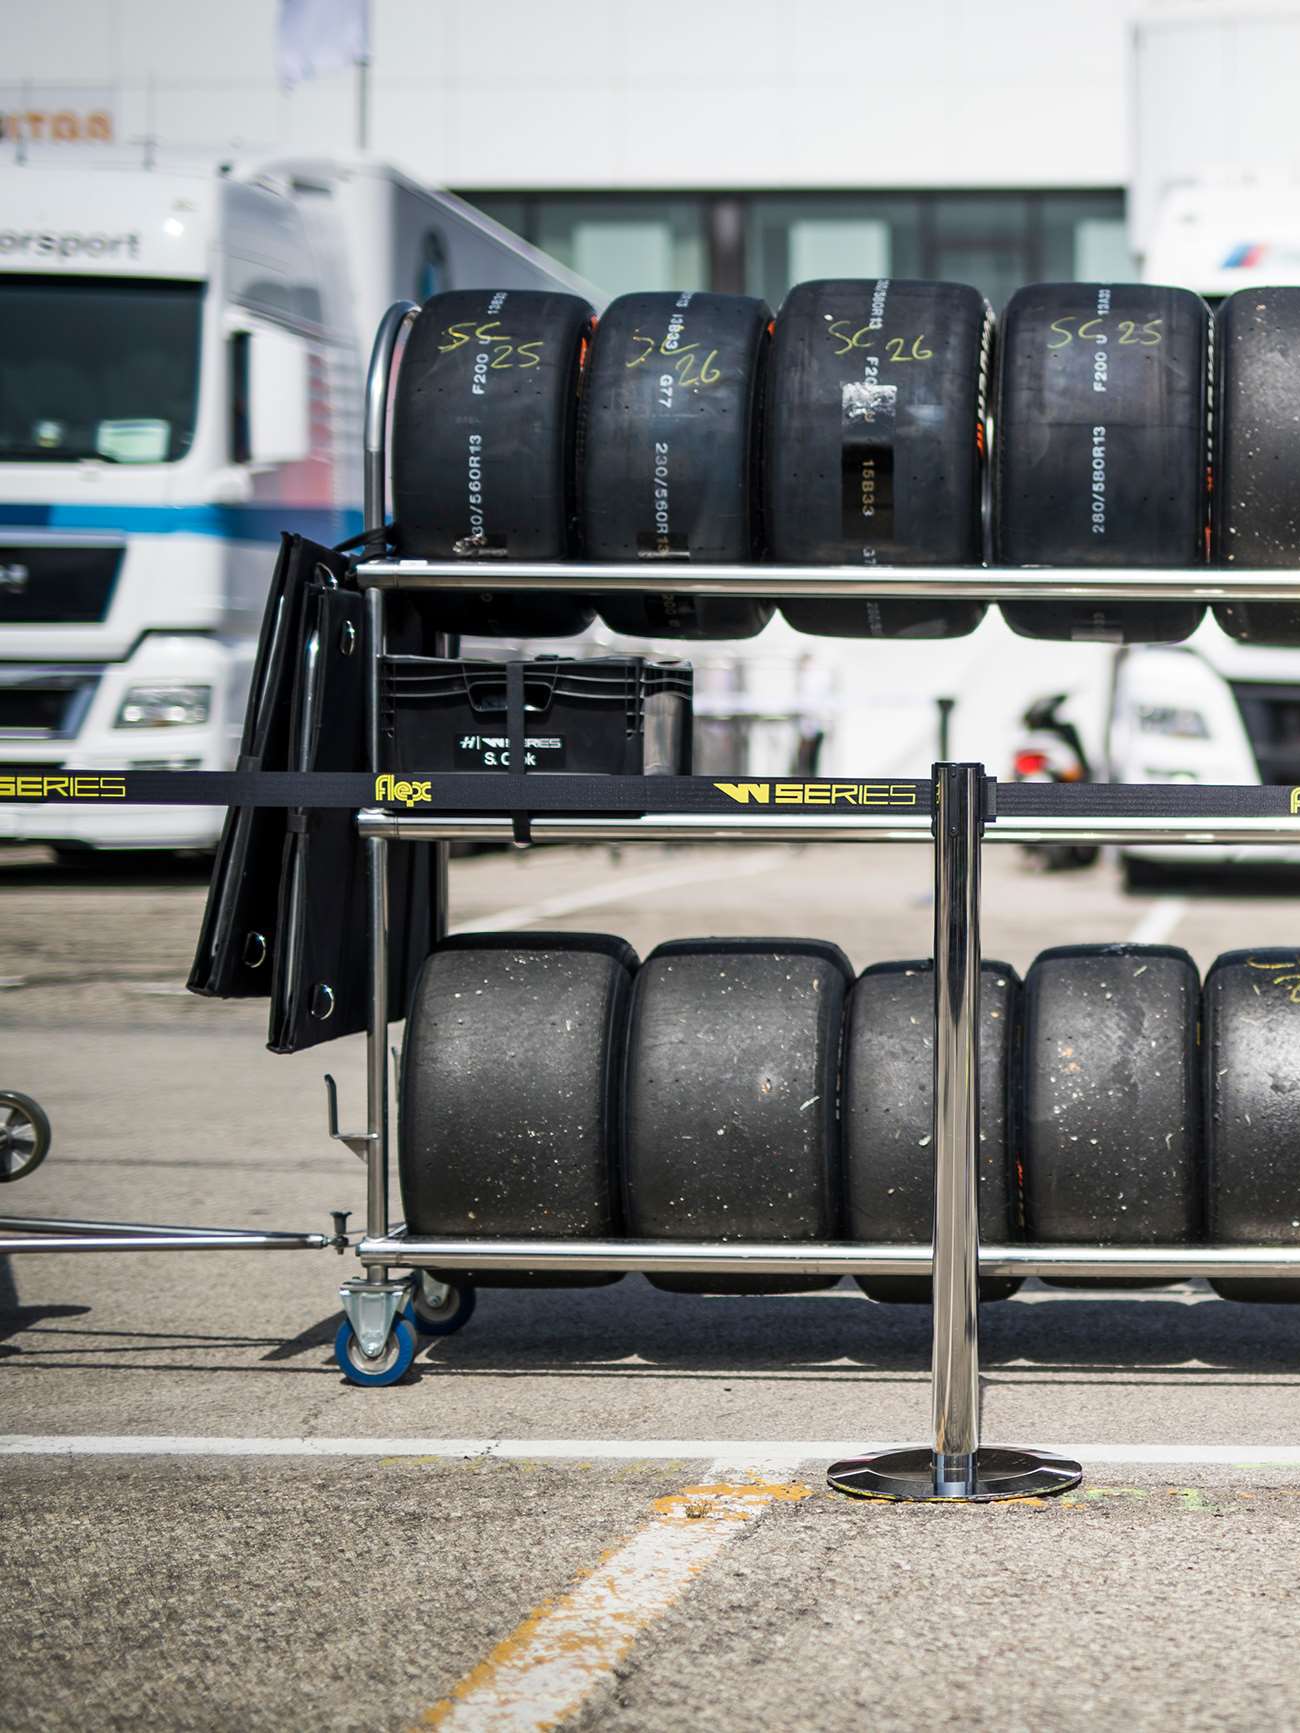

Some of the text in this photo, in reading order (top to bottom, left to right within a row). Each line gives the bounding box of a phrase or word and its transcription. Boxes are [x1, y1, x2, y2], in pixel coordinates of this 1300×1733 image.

[828, 320, 933, 362] SC 26
[1047, 316, 1163, 349] SC 25
[490, 341, 544, 368] 25
[674, 350, 721, 387] 26
[1093, 351, 1108, 392] F200
[472, 353, 490, 395] F200
[658, 373, 675, 408] G77
[1091, 426, 1106, 534] 280/580R13
[501, 752, 536, 766] Ck
[376, 775, 432, 807] flex
[775, 784, 916, 805] SERIES
